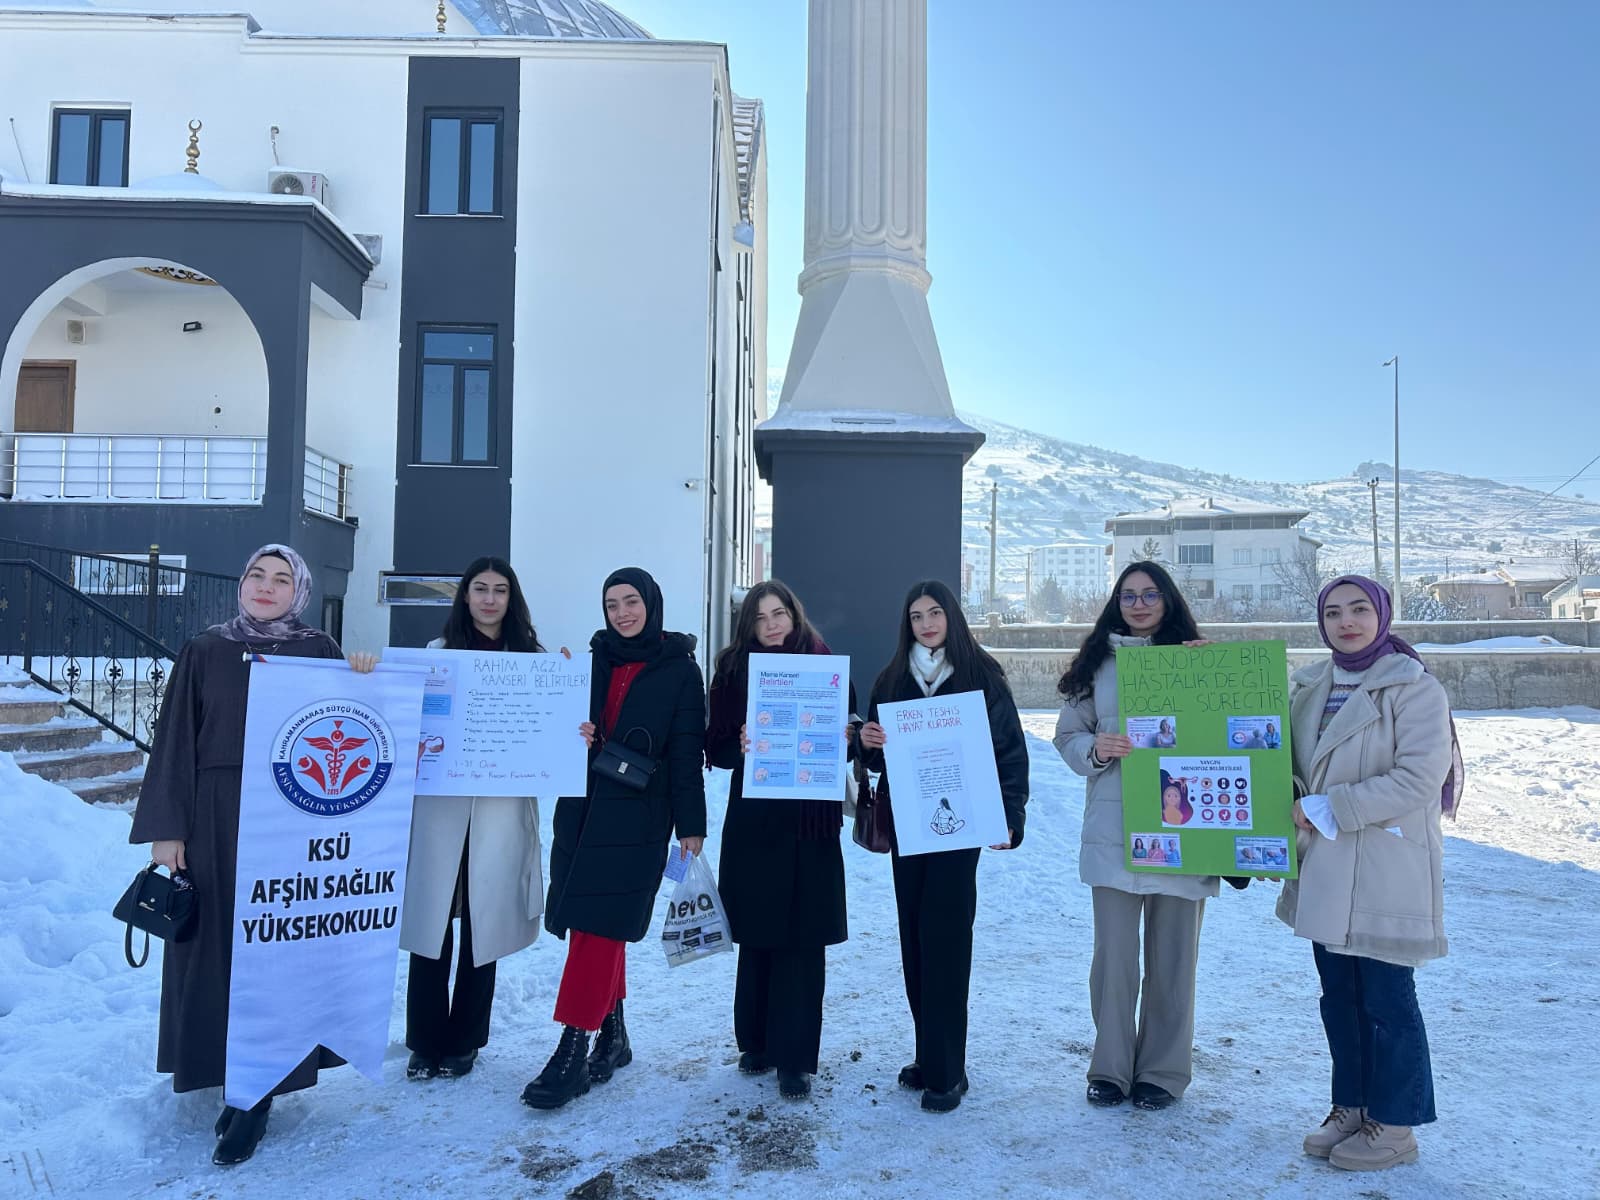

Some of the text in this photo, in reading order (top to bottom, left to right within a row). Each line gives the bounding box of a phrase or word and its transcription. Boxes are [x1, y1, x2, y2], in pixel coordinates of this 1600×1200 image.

[1126, 645, 1271, 671] MENOPOZ BİR
[1122, 672, 1209, 693] HASTALIK
[896, 709, 923, 721] ERKEN
[896, 720, 923, 733] HAYAT
[279, 705, 390, 761] KAHRAMANMARAŞ SÜTÇÜ İMAM ÜNİVERSİTESİ
[277, 767, 388, 812] AFŞİN SAĞLIK YÜKSEKOKULU
[308, 832, 351, 862] KSÜ
[250, 867, 396, 909] AFŞİN SAĞLIK
[242, 906, 398, 944] YÜKSEKOKULU
